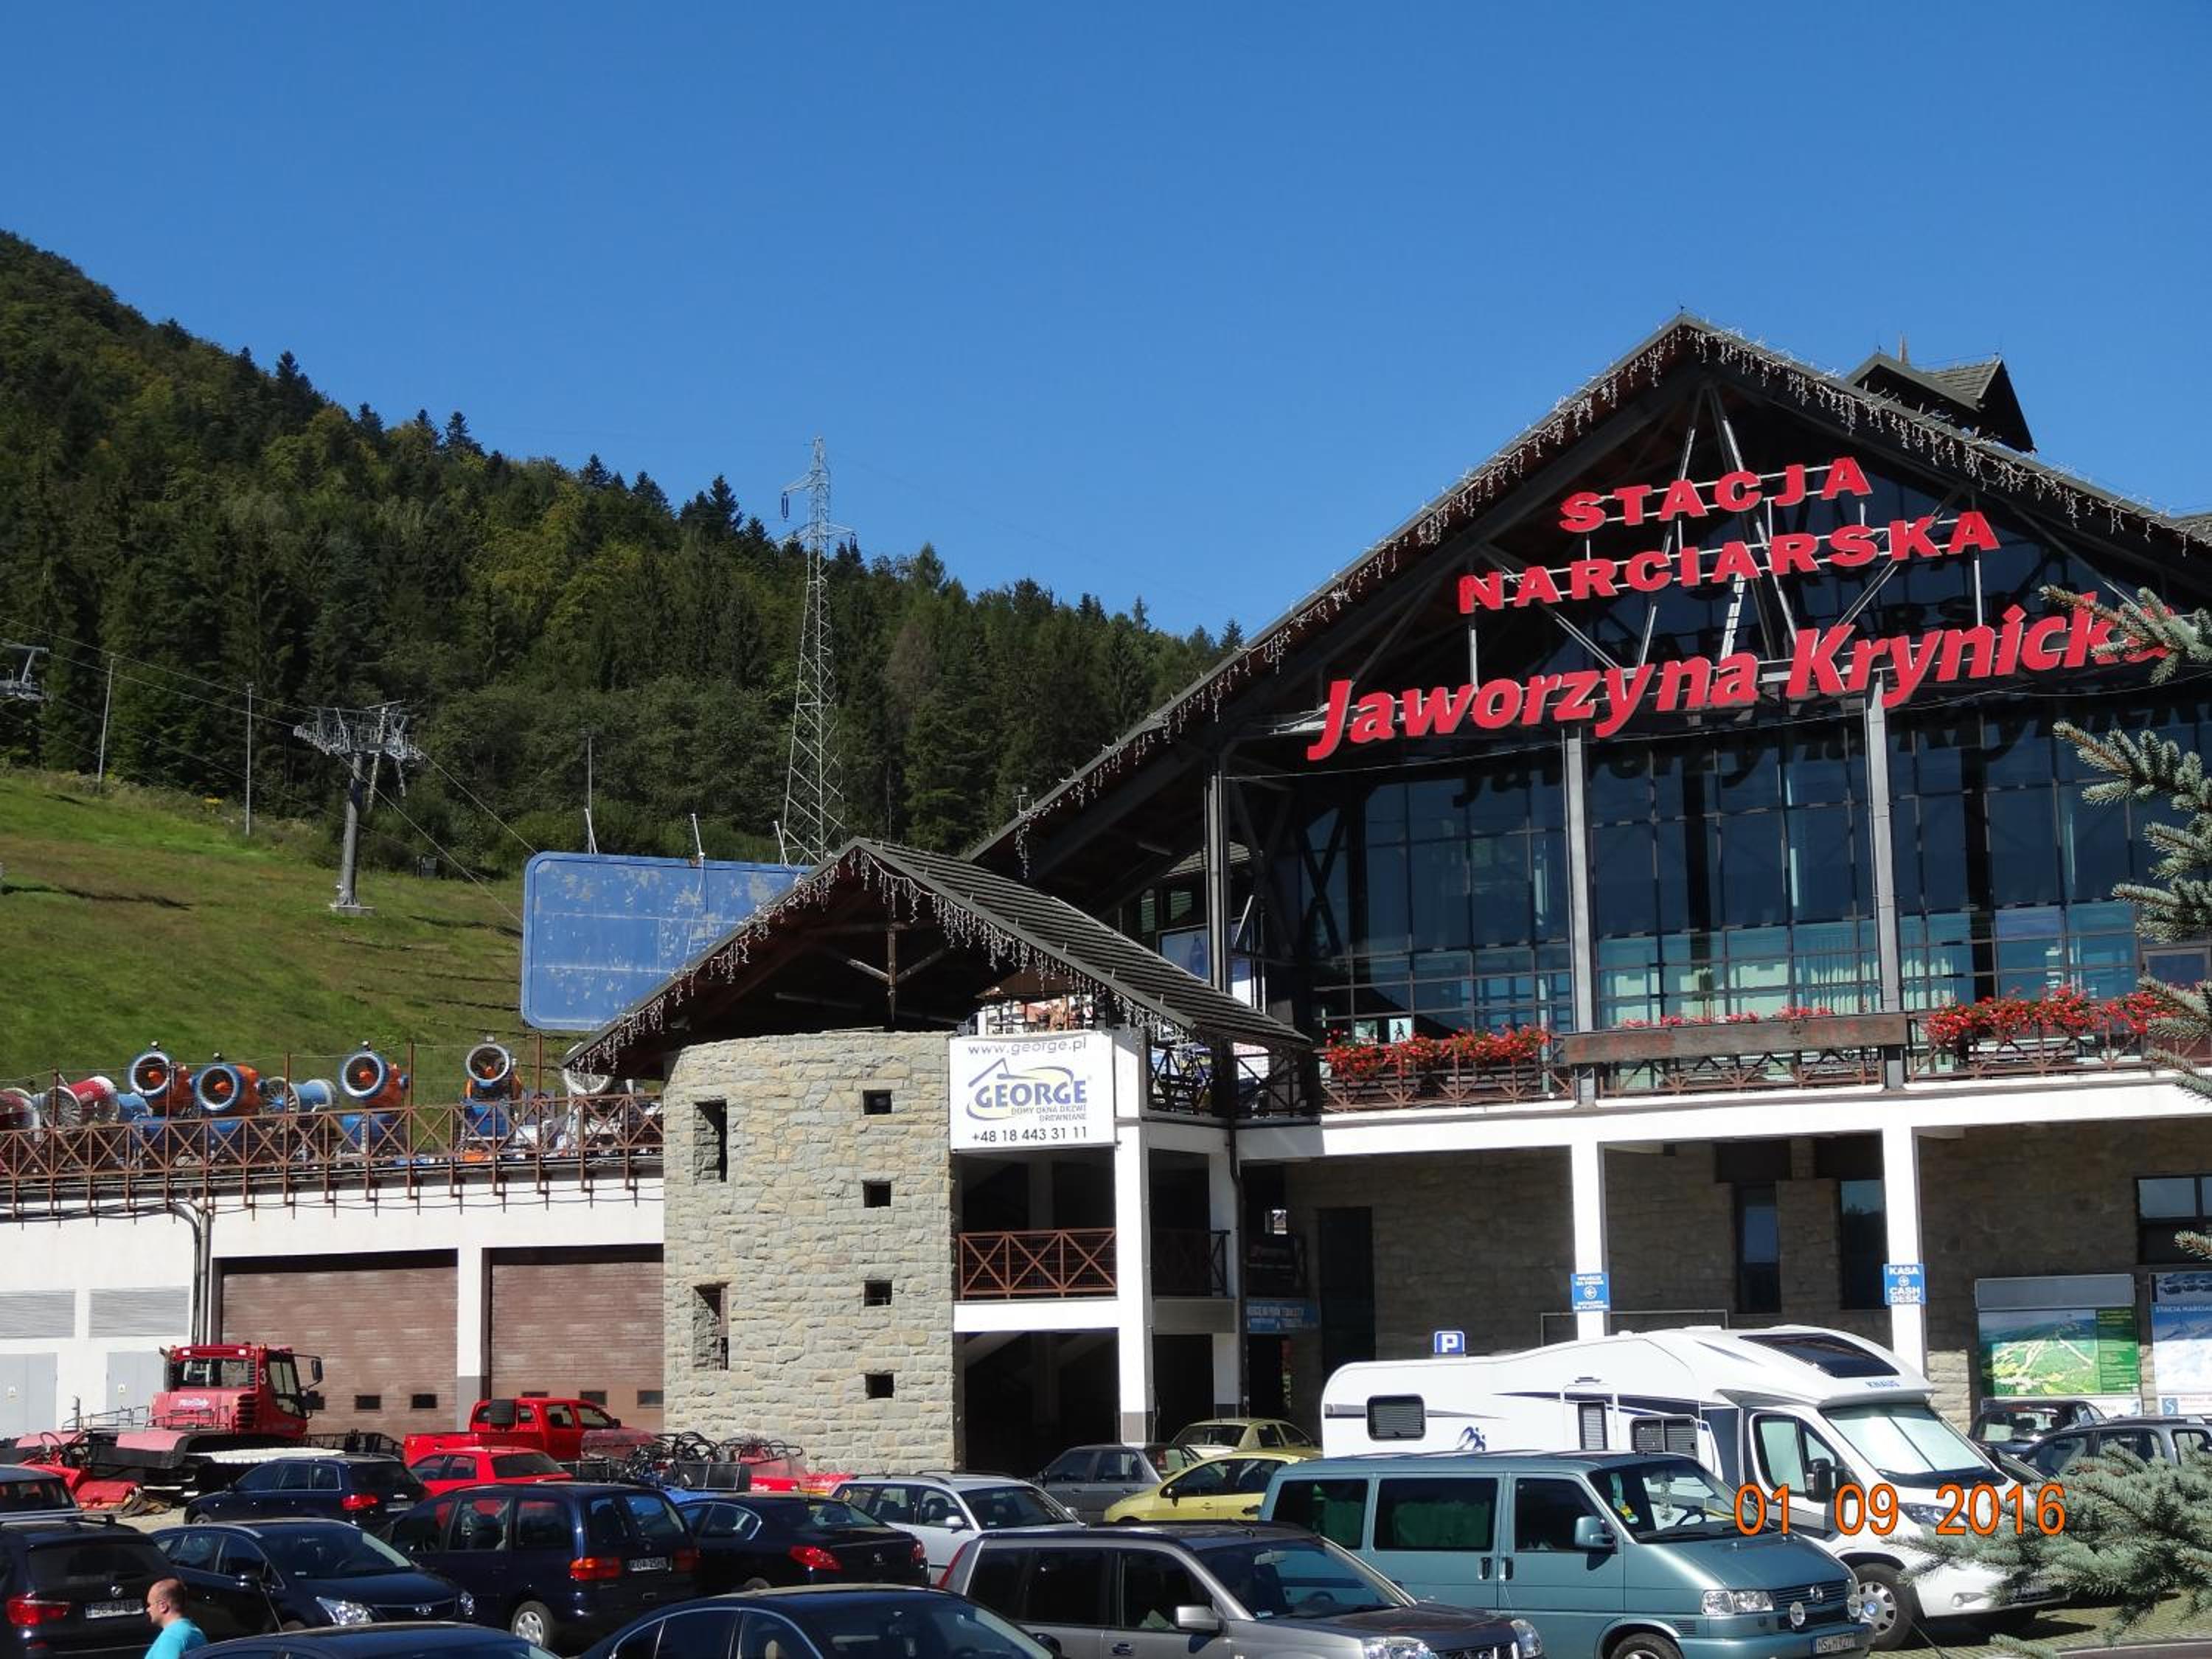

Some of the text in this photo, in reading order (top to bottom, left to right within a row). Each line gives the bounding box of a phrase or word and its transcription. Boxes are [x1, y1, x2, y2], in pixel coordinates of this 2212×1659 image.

[1559, 457, 1872, 532] STACJA
[1458, 511, 2000, 614] NARCIARSKA
[1307, 652, 1760, 761] Jaworzyna
[968, 1037, 1086, 1055] www.george.pl
[974, 1080, 1088, 1108] GEORGE
[972, 1125, 1087, 1143] +48 18 443 31 11
[1888, 1266, 1920, 1275] KASA
[1889, 1286, 1921, 1296] CASH
[1890, 1295, 1921, 1304] DESK
[1441, 1334, 1459, 1353] P
[259, 1368, 267, 1385] 3
